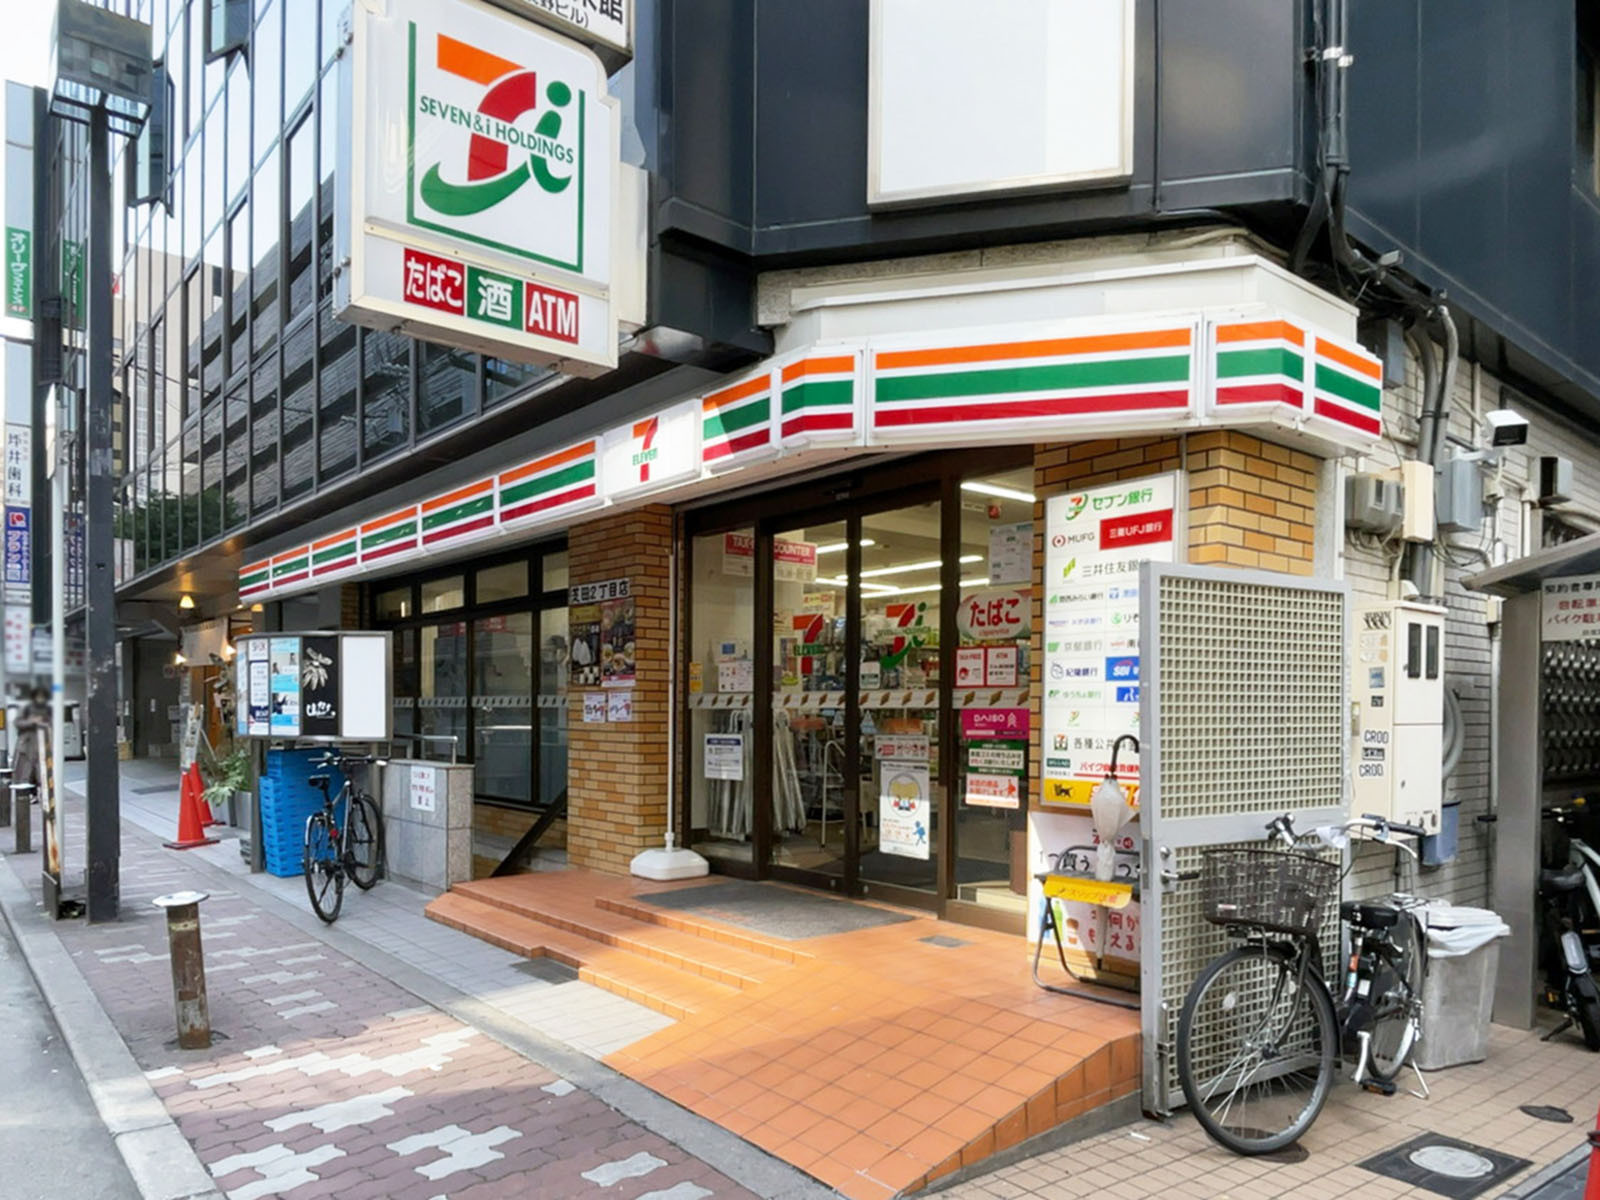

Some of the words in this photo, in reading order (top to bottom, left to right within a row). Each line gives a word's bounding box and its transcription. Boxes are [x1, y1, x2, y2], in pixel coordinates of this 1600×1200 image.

[496, 123, 574, 164] HOLDINGS
[406, 256, 463, 308] たばこ
[477, 276, 513, 321] 酒
[528, 290, 576, 338] ATM
[1092, 488, 1153, 510] セブン銀行
[1067, 532, 1095, 545] MUFG
[1082, 559, 1151, 577] 三井住友銀
[970, 598, 1021, 627] たばこ
[974, 713, 1005, 723] DAISO
